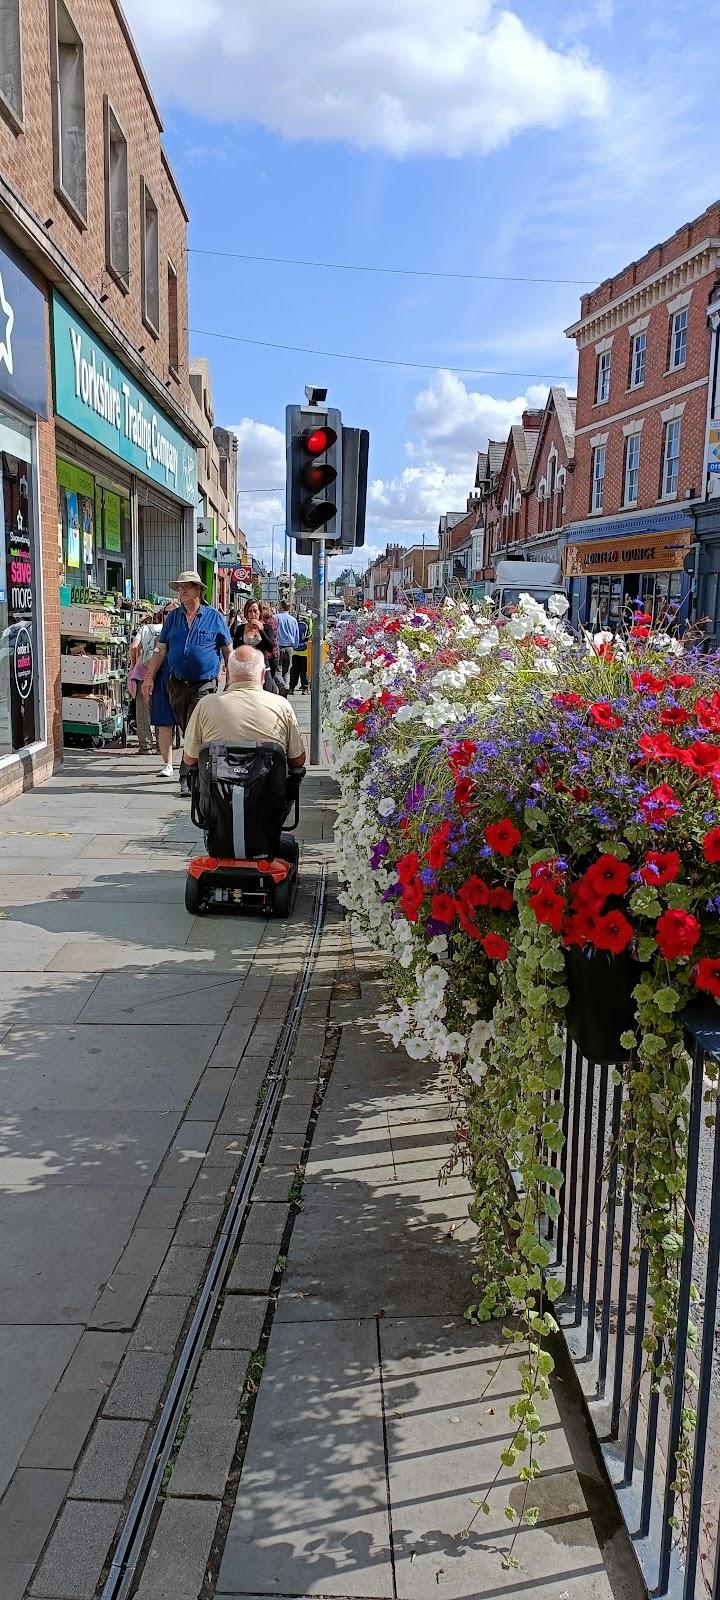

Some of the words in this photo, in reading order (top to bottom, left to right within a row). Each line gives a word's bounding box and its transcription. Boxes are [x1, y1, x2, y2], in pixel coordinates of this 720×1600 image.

[70, 328, 121, 431] Yorkshire
[121, 382, 152, 470] Trading
[151, 414, 179, 488] Company
[584, 550, 618, 565] MONTERO
[621, 546, 656, 561] LOUNGE
[11, 561, 32, 583] save
[12, 587, 32, 609] more
